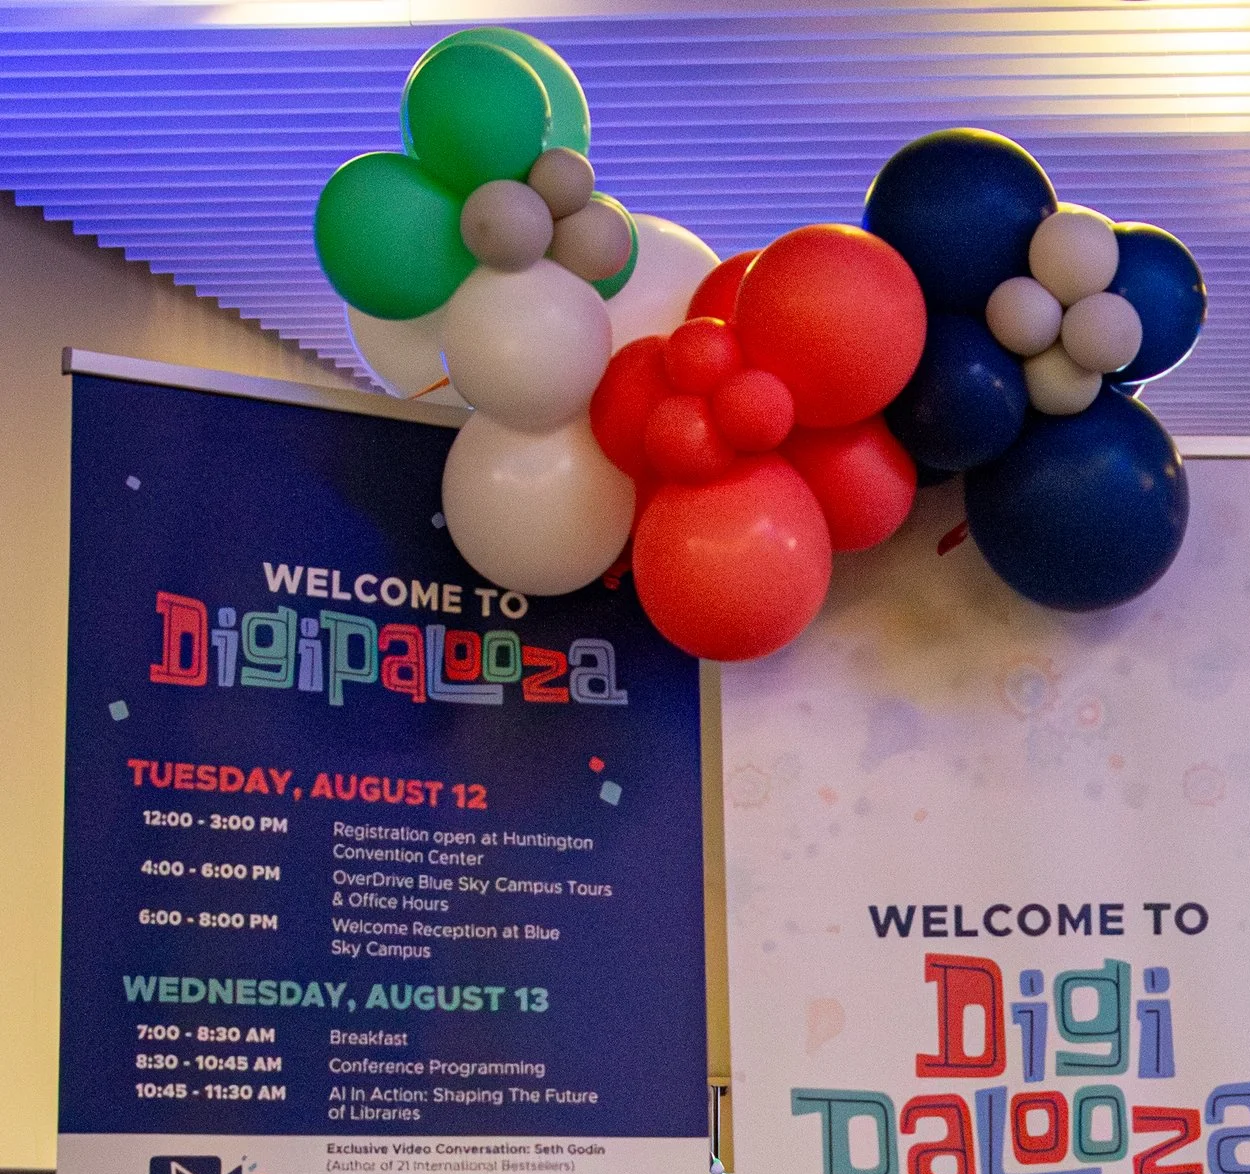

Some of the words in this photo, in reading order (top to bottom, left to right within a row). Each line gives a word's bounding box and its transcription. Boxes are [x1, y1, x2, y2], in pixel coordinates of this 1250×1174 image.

[263, 562, 461, 615] WELCOME
[475, 589, 528, 619] TO
[126, 757, 304, 802] TUESDAY,
[309, 771, 445, 808] AUGUST
[450, 782, 489, 811] 12
[142, 809, 194, 829] 12:00
[209, 812, 256, 832] 3:00
[259, 815, 289, 834] PM
[332, 820, 430, 842] Registration
[432, 830, 476, 847] open
[480, 831, 499, 846] at
[502, 831, 594, 852] Huntington
[332, 842, 423, 863] Convention
[428, 849, 485, 866] Center
[140, 858, 186, 878] 4:00
[199, 861, 249, 881] 6:00
[251, 864, 282, 882] PM
[332, 869, 414, 889] OverDrive
[418, 874, 454, 891] Blue
[458, 875, 490, 896] Sky
[494, 876, 563, 896] Campus
[566, 879, 614, 898] Tours
[331, 890, 344, 907] &
[348, 892, 398, 910] Office
[402, 896, 450, 912] Hours
[331, 917, 409, 936] Welcome
[412, 921, 498, 941] Reception
[501, 924, 520, 940] at
[523, 923, 561, 941] Blue
[867, 903, 1125, 938] WELCOME
[1143, 901, 1210, 936] TO
[331, 938, 361, 959] Sky
[365, 940, 432, 961] Campus
[122, 975, 357, 1013] WEDNESDAY,
[364, 983, 506, 1012] AUGUST
[514, 986, 550, 1013] 13
[915, 952, 1176, 1083] Digi
[135, 1023, 181, 1042] 7:00
[195, 1025, 242, 1043] 8:30
[244, 1026, 276, 1044] AM
[329, 1028, 408, 1047] Breakfast
[328, 1057, 425, 1075] Conference
[428, 1058, 546, 1079] Programming
[134, 1082, 189, 1100] 10:45
[203, 1083, 254, 1101] 11:30
[256, 1084, 287, 1102] AM
[328, 1085, 347, 1101] AI
[350, 1087, 366, 1101] In
[369, 1087, 428, 1103] Action:
[432, 1087, 504, 1106] Shaping
[508, 1087, 541, 1104] The
[544, 1087, 599, 1105] Future
[327, 1104, 346, 1120] of
[350, 1105, 421, 1121] Libraries
[326, 1143, 388, 1155] Exclusive
[392, 1144, 433, 1155] Video
[436, 1144, 531, 1155] Conversation:
[535, 1144, 566, 1156] Seth
[568, 1144, 607, 1156] Godin
[380, 1160, 394, 1171] of
